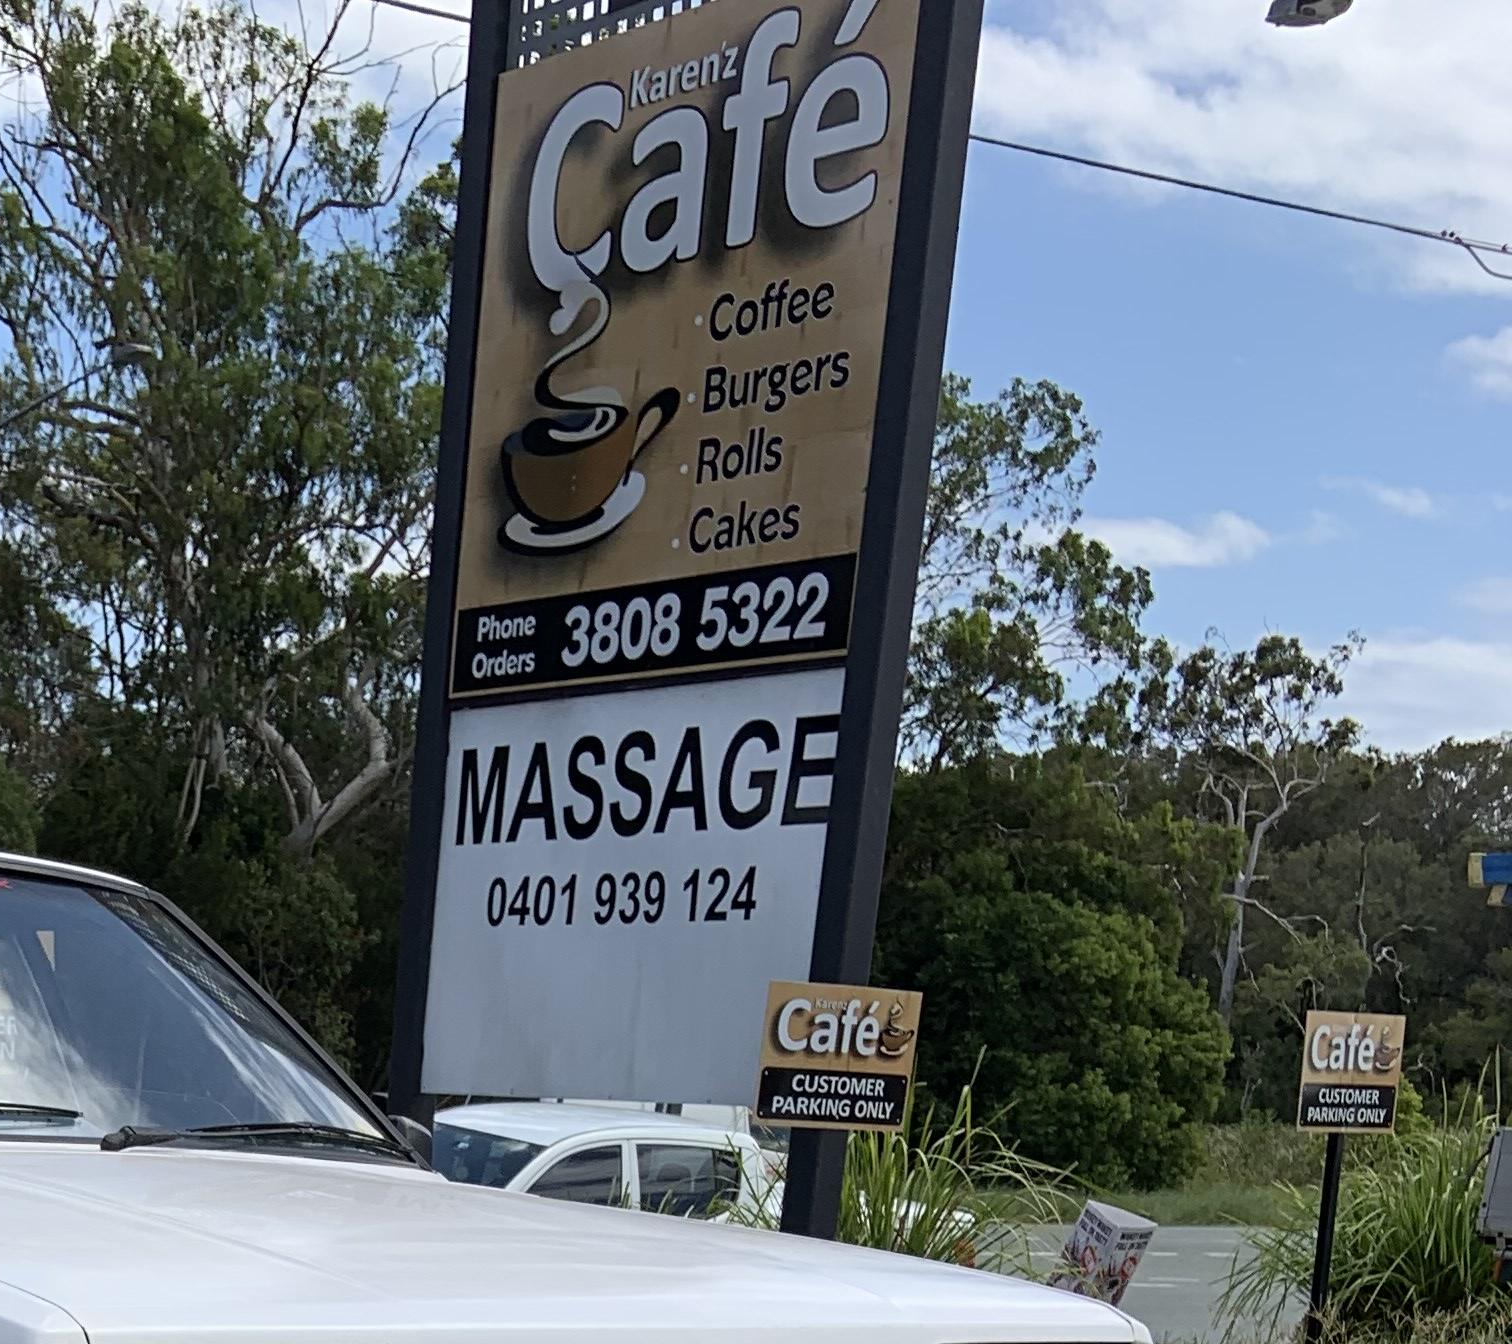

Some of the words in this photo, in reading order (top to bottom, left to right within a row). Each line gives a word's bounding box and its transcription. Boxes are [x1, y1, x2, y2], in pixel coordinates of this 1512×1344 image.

[629, 40, 740, 109] Karen'z
[528, 0, 890, 287] Café
[709, 279, 835, 341] Coffee
[702, 351, 850, 414] Burgers
[695, 427, 783, 484] Rolls
[689, 500, 801, 553] Cakes
[476, 614, 536, 643] Phone
[560, 592, 682, 668] 3808
[695, 571, 829, 651] 5322
[471, 650, 535, 680] Orders
[454, 713, 842, 846] MASSAGE
[487, 873, 579, 927] 0401
[594, 870, 666, 924] 939
[682, 866, 758, 922] 124
[777, 998, 881, 1056] Café
[1311, 1023, 1375, 1072] Café
[770, 1096, 851, 1119] PARKING
[854, 1101, 895, 1120] ONLY
[791, 1074, 886, 1098] CUSTOMER
[1318, 1088, 1380, 1106] CUSTOMER
[1306, 1106, 1355, 1123] PARKING
[1356, 1107, 1387, 1124] ONLY
